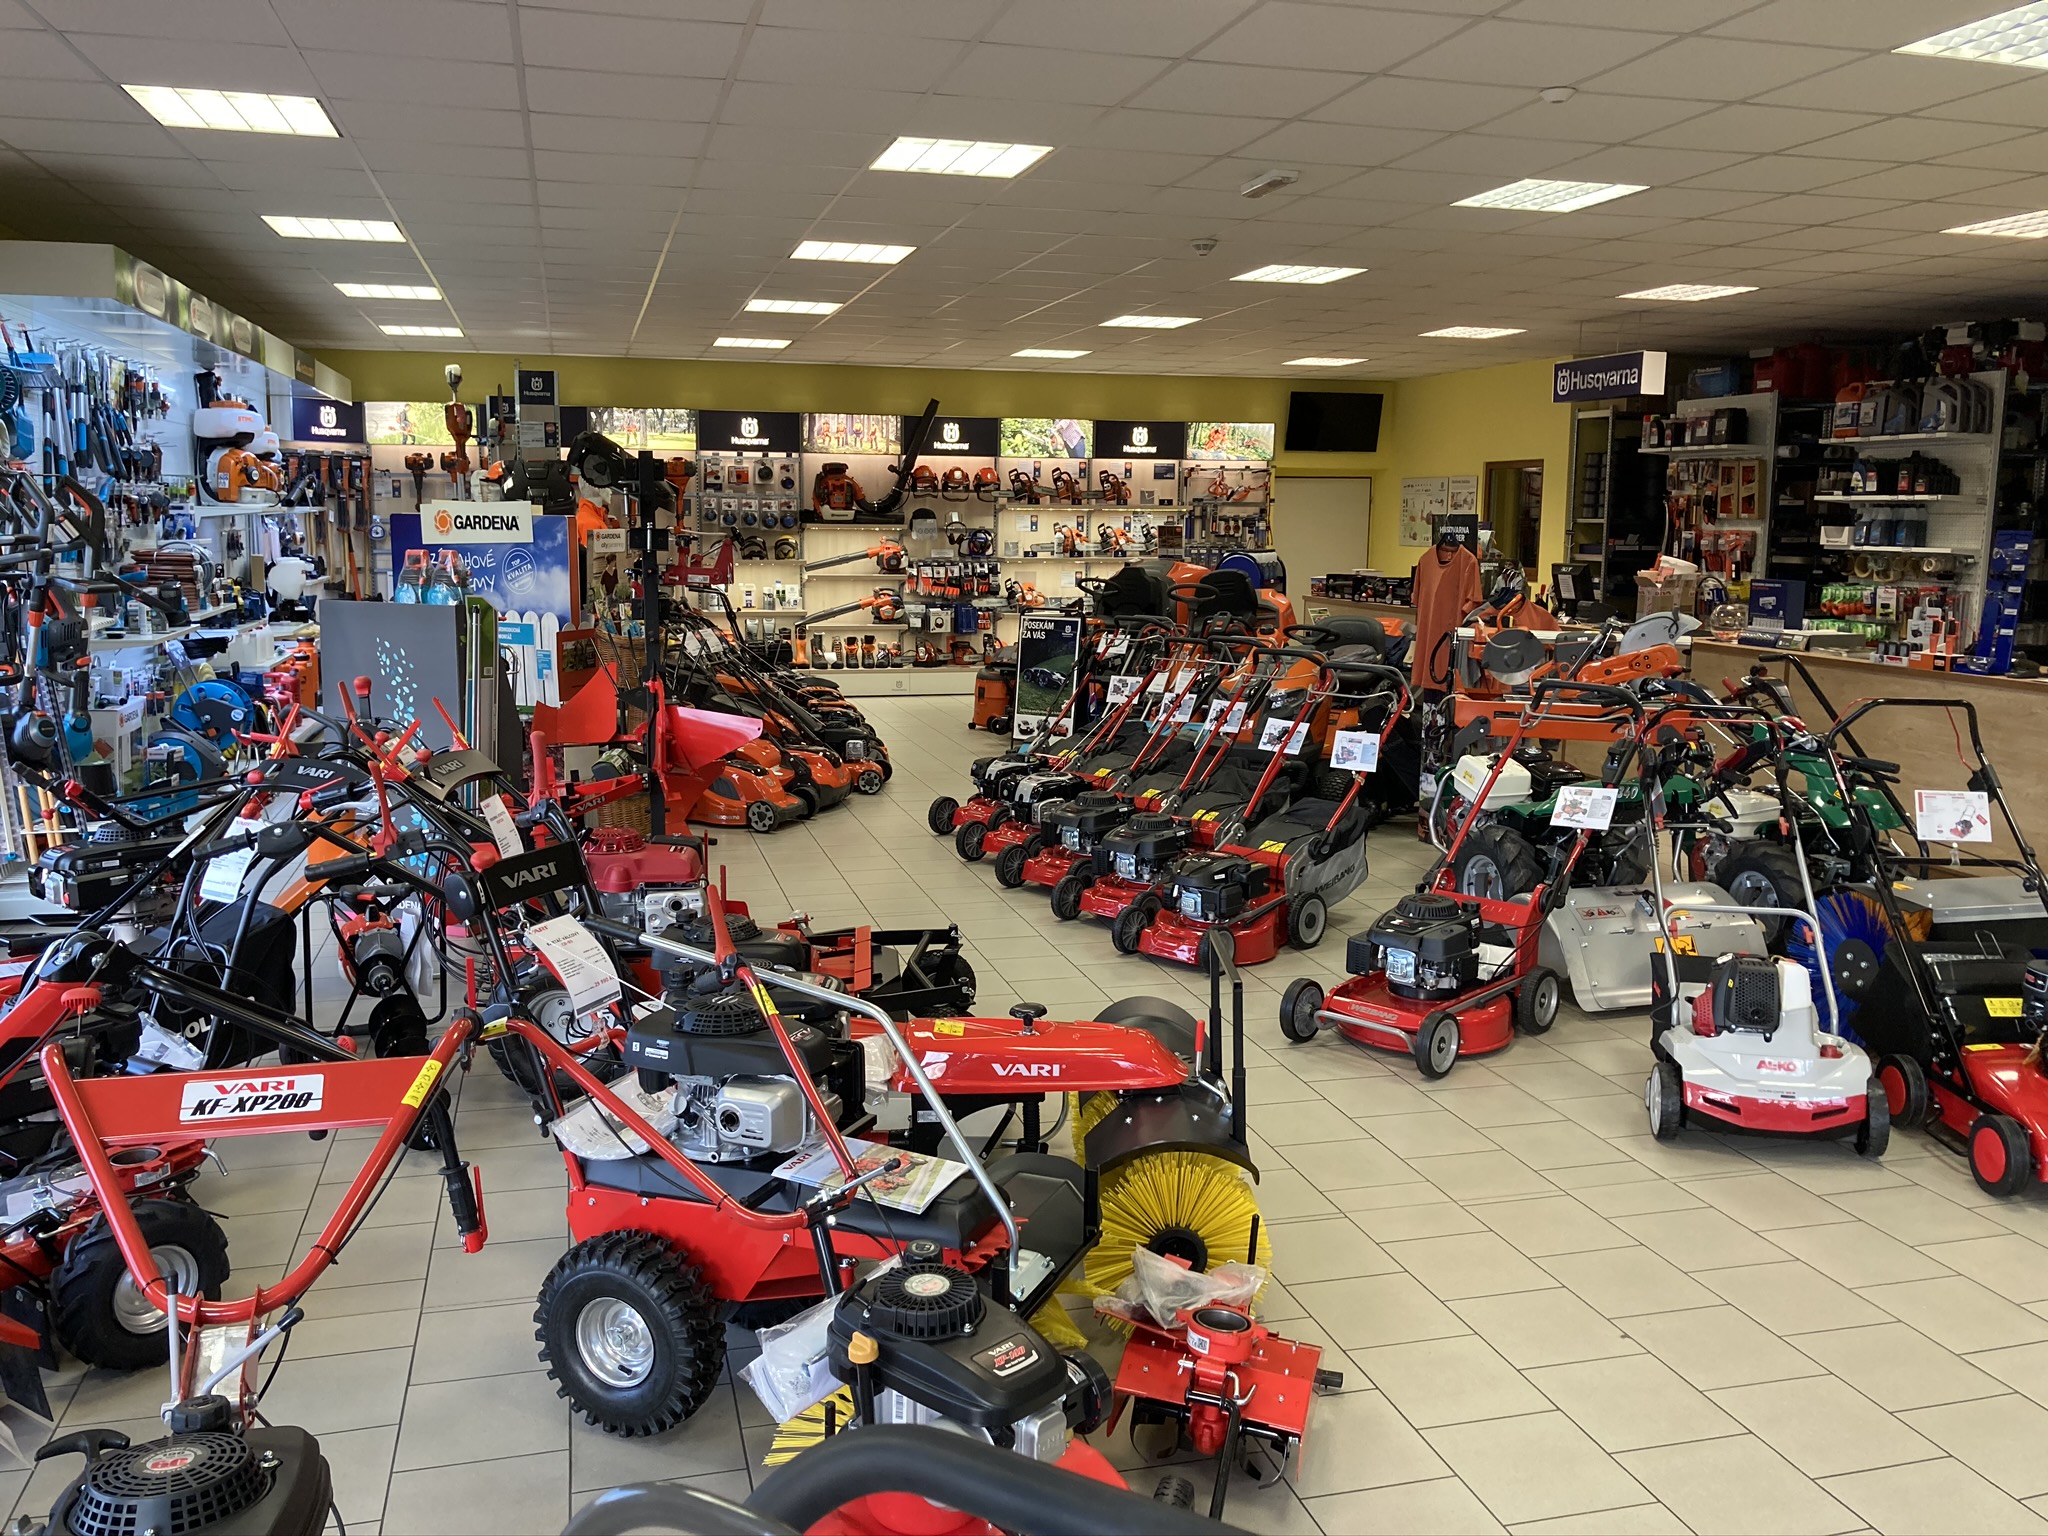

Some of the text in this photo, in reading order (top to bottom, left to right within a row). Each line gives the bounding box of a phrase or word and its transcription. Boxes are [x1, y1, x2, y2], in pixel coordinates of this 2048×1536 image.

[1570, 367, 1639, 391] Husqvarna
[311, 426, 347, 437] Husqvarna
[730, 436, 770, 446] Husqvarna
[933, 442, 969, 451] Husqvarna
[1122, 445, 1157, 454] Husqvarna
[454, 514, 520, 531] GARDENA
[601, 532, 622, 540] GARDENA
[511, 558, 521, 567] TOP
[506, 563, 533, 581] KVALITA
[1023, 620, 1055, 630] POSEKÁM
[1022, 629, 1046, 639] ZA VÁS
[297, 765, 336, 779] VARI
[434, 759, 465, 775] VARI
[576, 796, 606, 812] VARI
[501, 861, 558, 889] VARI
[1314, 863, 1356, 893] WEIBANG
[1350, 1003, 1400, 1022] WEIBANG
[788, 1027, 812, 1043] GCV
[992, 1063, 1060, 1077] VARI
[214, 1080, 295, 1095] VARI
[190, 1092, 314, 1117] KF-XP200
[782, 1153, 813, 1170] VARI
[988, 1341, 1014, 1356] VARI
